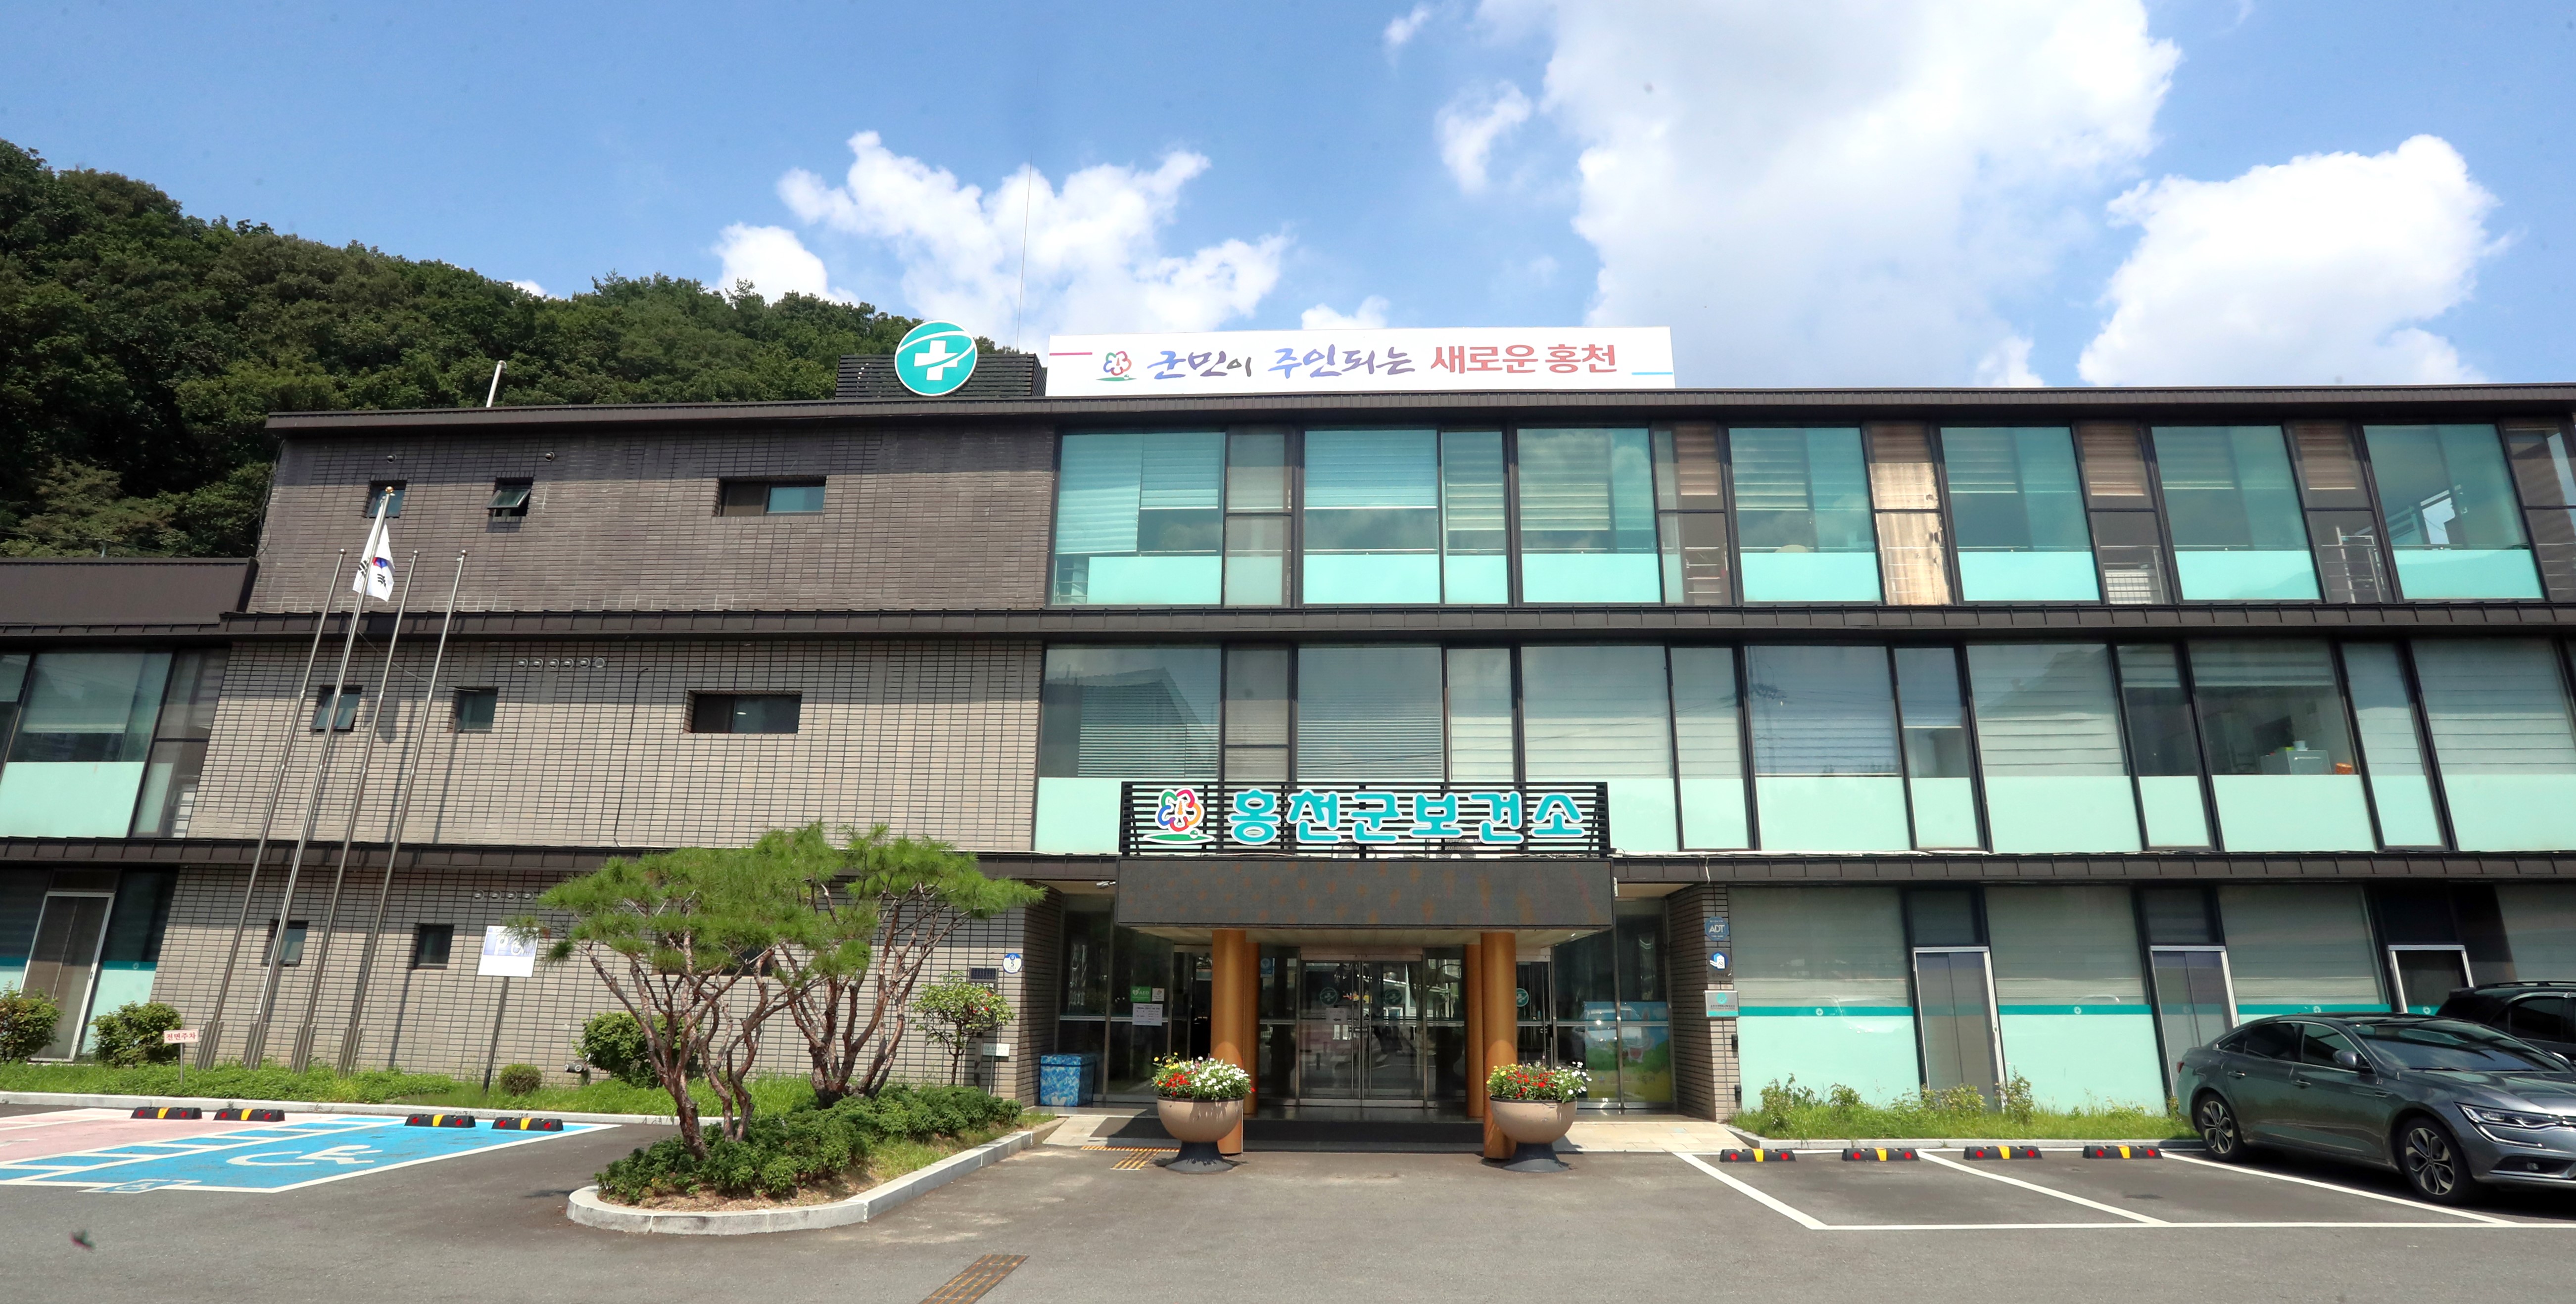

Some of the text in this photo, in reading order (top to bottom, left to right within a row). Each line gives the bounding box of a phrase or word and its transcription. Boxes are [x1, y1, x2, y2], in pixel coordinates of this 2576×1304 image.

[1147, 344, 1617, 379] 군민이 주인되는 새로운 홍천
[1228, 788, 1585, 845] 홍천군보건소
[1709, 924, 1725, 933] ADT
[166, 1032, 196, 1041] 전면주차
